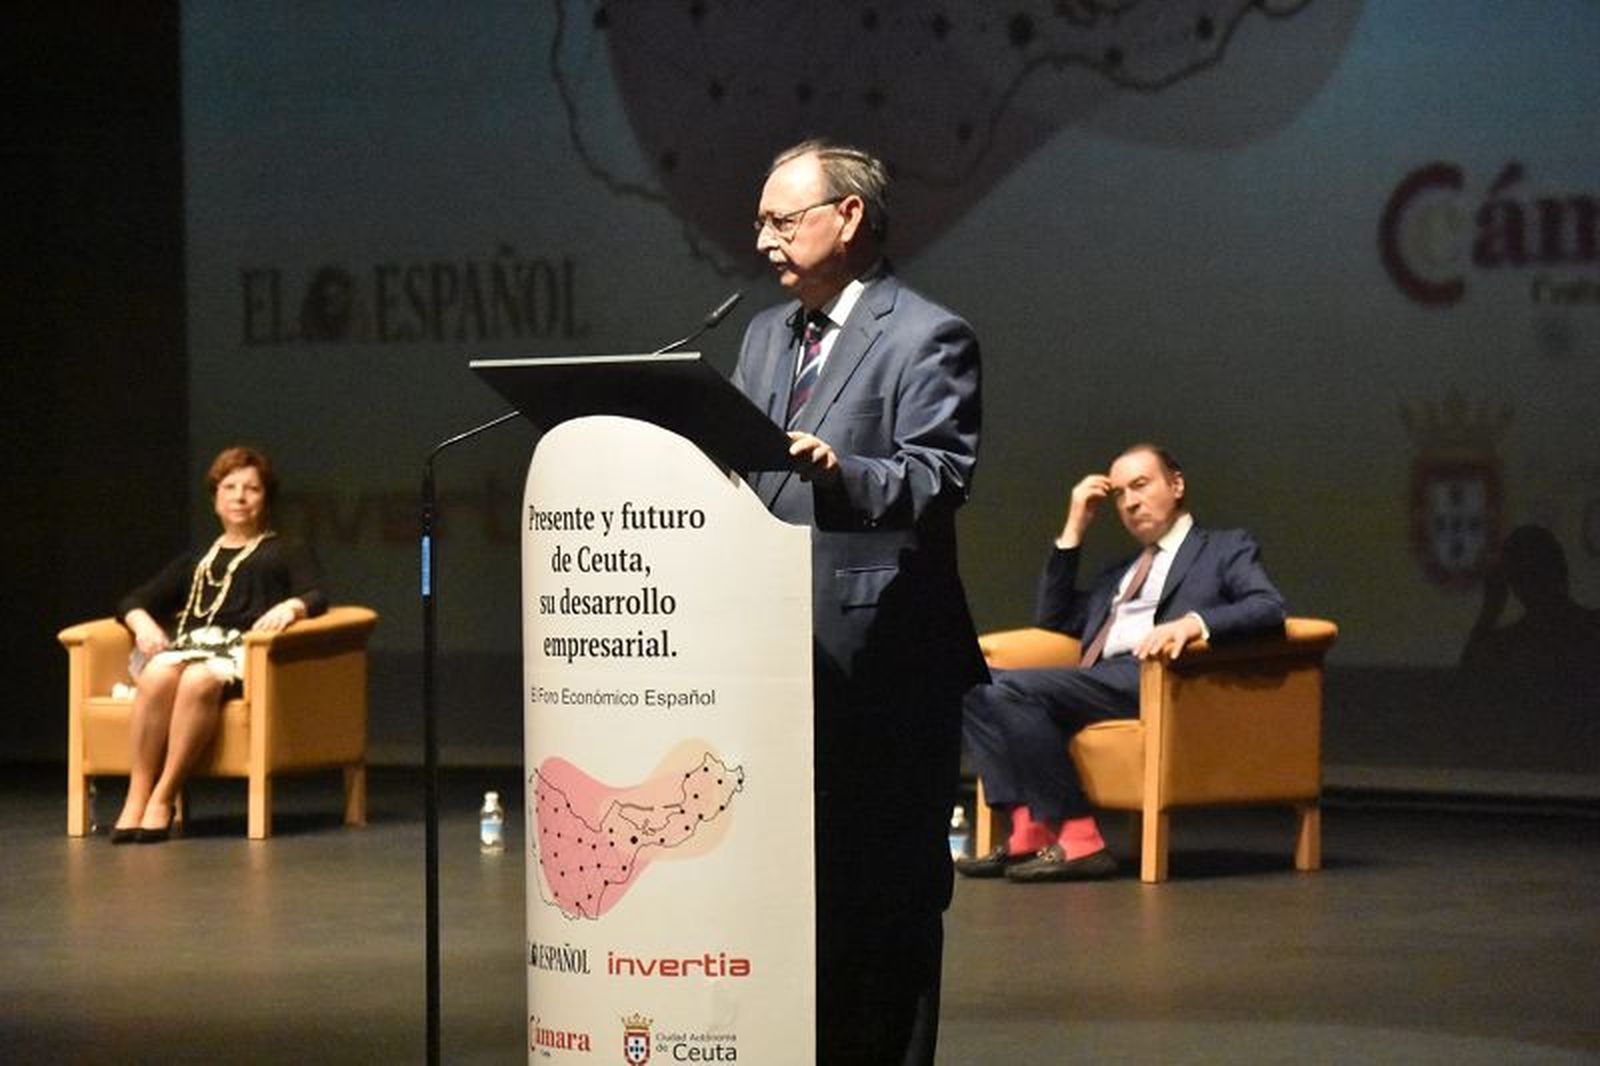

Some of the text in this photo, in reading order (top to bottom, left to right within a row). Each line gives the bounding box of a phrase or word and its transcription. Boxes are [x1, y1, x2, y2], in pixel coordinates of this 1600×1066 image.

[374, 242, 592, 345] ESPAÑOL
[528, 502, 706, 536] Presente y futuro
[551, 546, 651, 577] de Ceuta,
[540, 587, 676, 615] su desarrollo
[543, 630, 678, 664] empresarial.
[561, 687, 639, 705] Económico
[645, 689, 716, 710] Español
[539, 943, 591, 975] ESPAÑOL
[607, 951, 751, 977] invertia
[655, 1043, 737, 1062] de Ceuta
